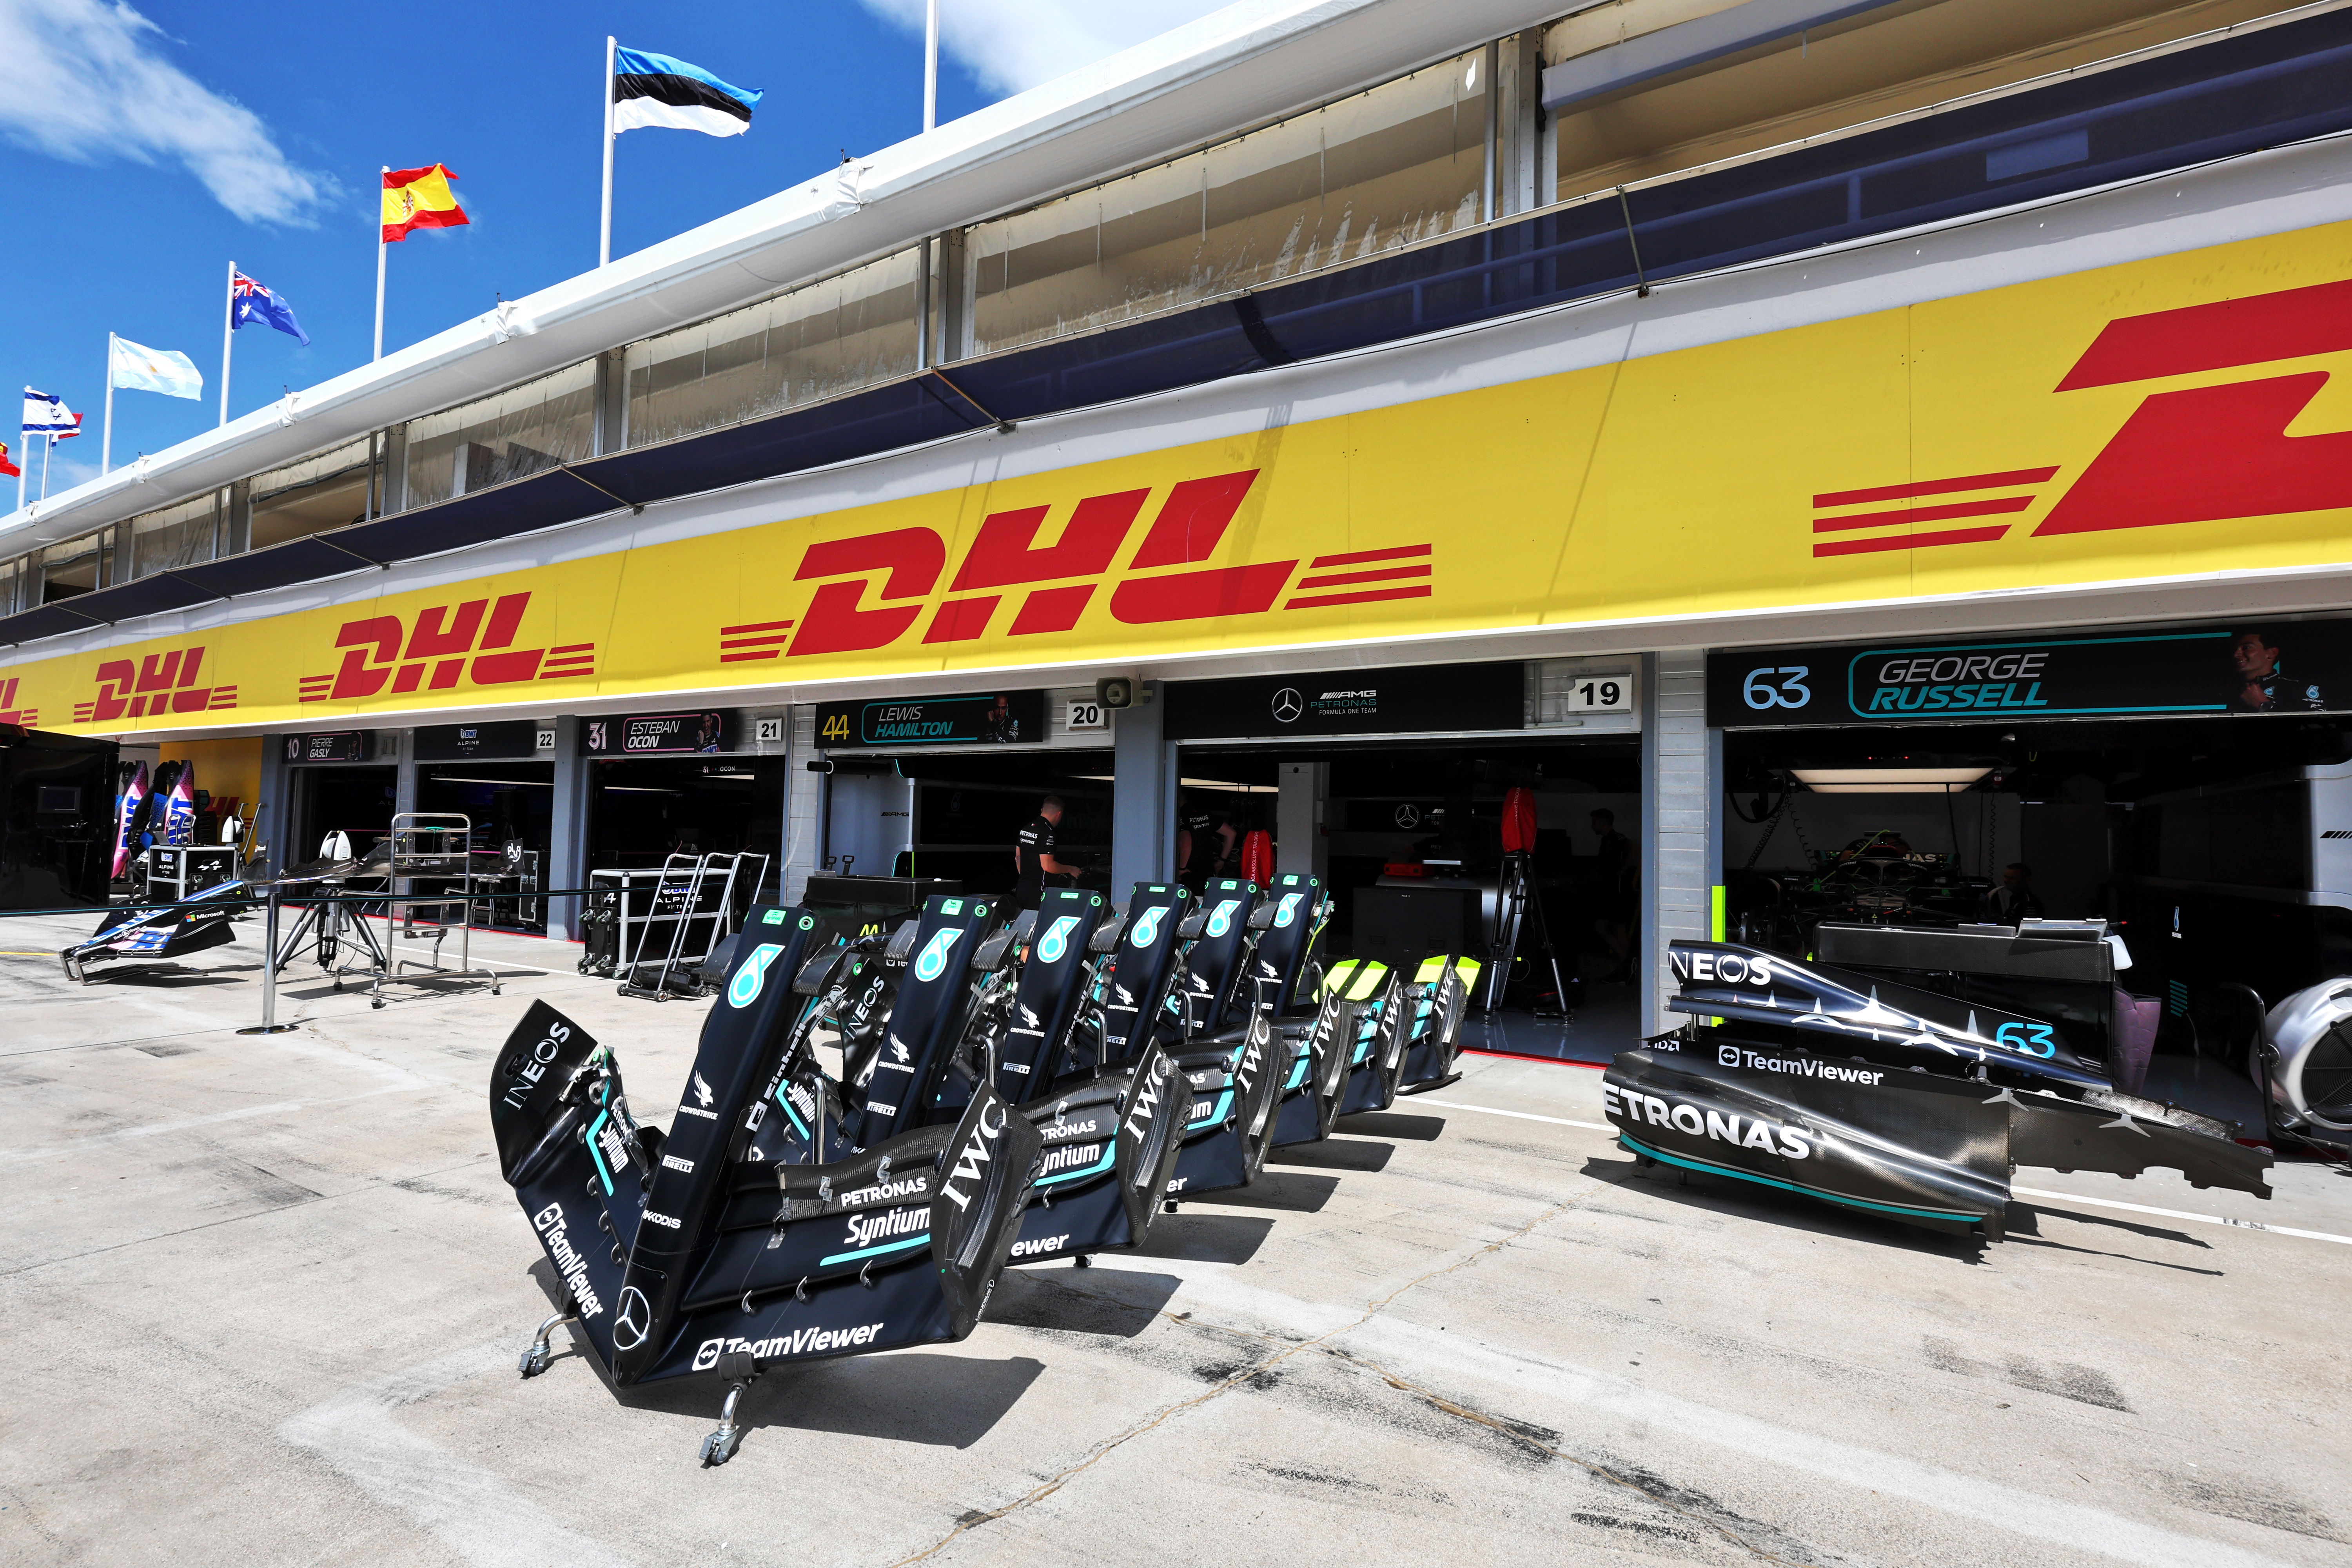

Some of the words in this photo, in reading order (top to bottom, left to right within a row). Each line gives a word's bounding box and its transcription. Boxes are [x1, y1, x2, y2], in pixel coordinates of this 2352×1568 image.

[786, 470, 1299, 656] DHL
[330, 592, 545, 699] DHL
[1878, 653, 2049, 683] GEORGE
[93, 647, 211, 720] DHL
[1338, 690, 1376, 699] AMG
[1579, 681, 1620, 706] 19
[1744, 666, 1810, 709] 63
[1869, 682, 2048, 711] RUSSELL
[879, 706, 923, 721] LEWIS
[1073, 706, 1098, 724] 20
[1310, 699, 1376, 708] PETRONAS
[465, 730, 477, 738] BWT
[540, 734, 552, 746] 22
[588, 722, 607, 750] 31
[628, 735, 659, 748] OCON
[631, 720, 680, 735] ESTEBAN
[762, 722, 776, 738] 21
[822, 715, 849, 740] 44
[875, 721, 953, 737] HAMILTON
[287, 738, 299, 759] 10
[309, 748, 330, 758] GASLY
[311, 737, 333, 748] PIERRE
[196, 910, 225, 920] Microsoft
[1669, 951, 1772, 985] NEOS
[1433, 964, 1455, 1020] IWC
[844, 976, 884, 1041] INEOS
[1380, 980, 1403, 1041] IWC
[1010, 1027, 1045, 1037] CROWDSTRIKE
[1312, 991, 1341, 1060] IWC
[1107, 1036, 1127, 1045] RELLI
[1237, 1014, 1269, 1094] IWC
[1996, 1022, 2056, 1059] 63
[503, 1022, 570, 1111] INEOS
[878, 1061, 915, 1073] CROWDSTRIKE
[1003, 1062, 1031, 1074] PIRELLI
[1743, 1051, 1884, 1086] TeamViewer
[866, 1101, 897, 1116] PIRELLI
[1124, 1051, 1169, 1144] IWC
[611, 1103, 632, 1146] PETRON
[679, 1105, 719, 1120] CROWDSTRIKE
[1602, 1082, 1810, 1159] ETRONAS
[1041, 1120, 1097, 1141] TRONAS
[599, 1121, 629, 1174] Syntium
[940, 1096, 1007, 1213] IWC
[1039, 1144, 1100, 1177] yntium
[662, 1154, 695, 1173] PIRELLI
[841, 1177, 927, 1207] PETRONAS
[844, 1206, 931, 1247] Syntium
[545, 1218, 604, 1320] TeamViewer
[726, 1323, 884, 1360] TeamViewer
